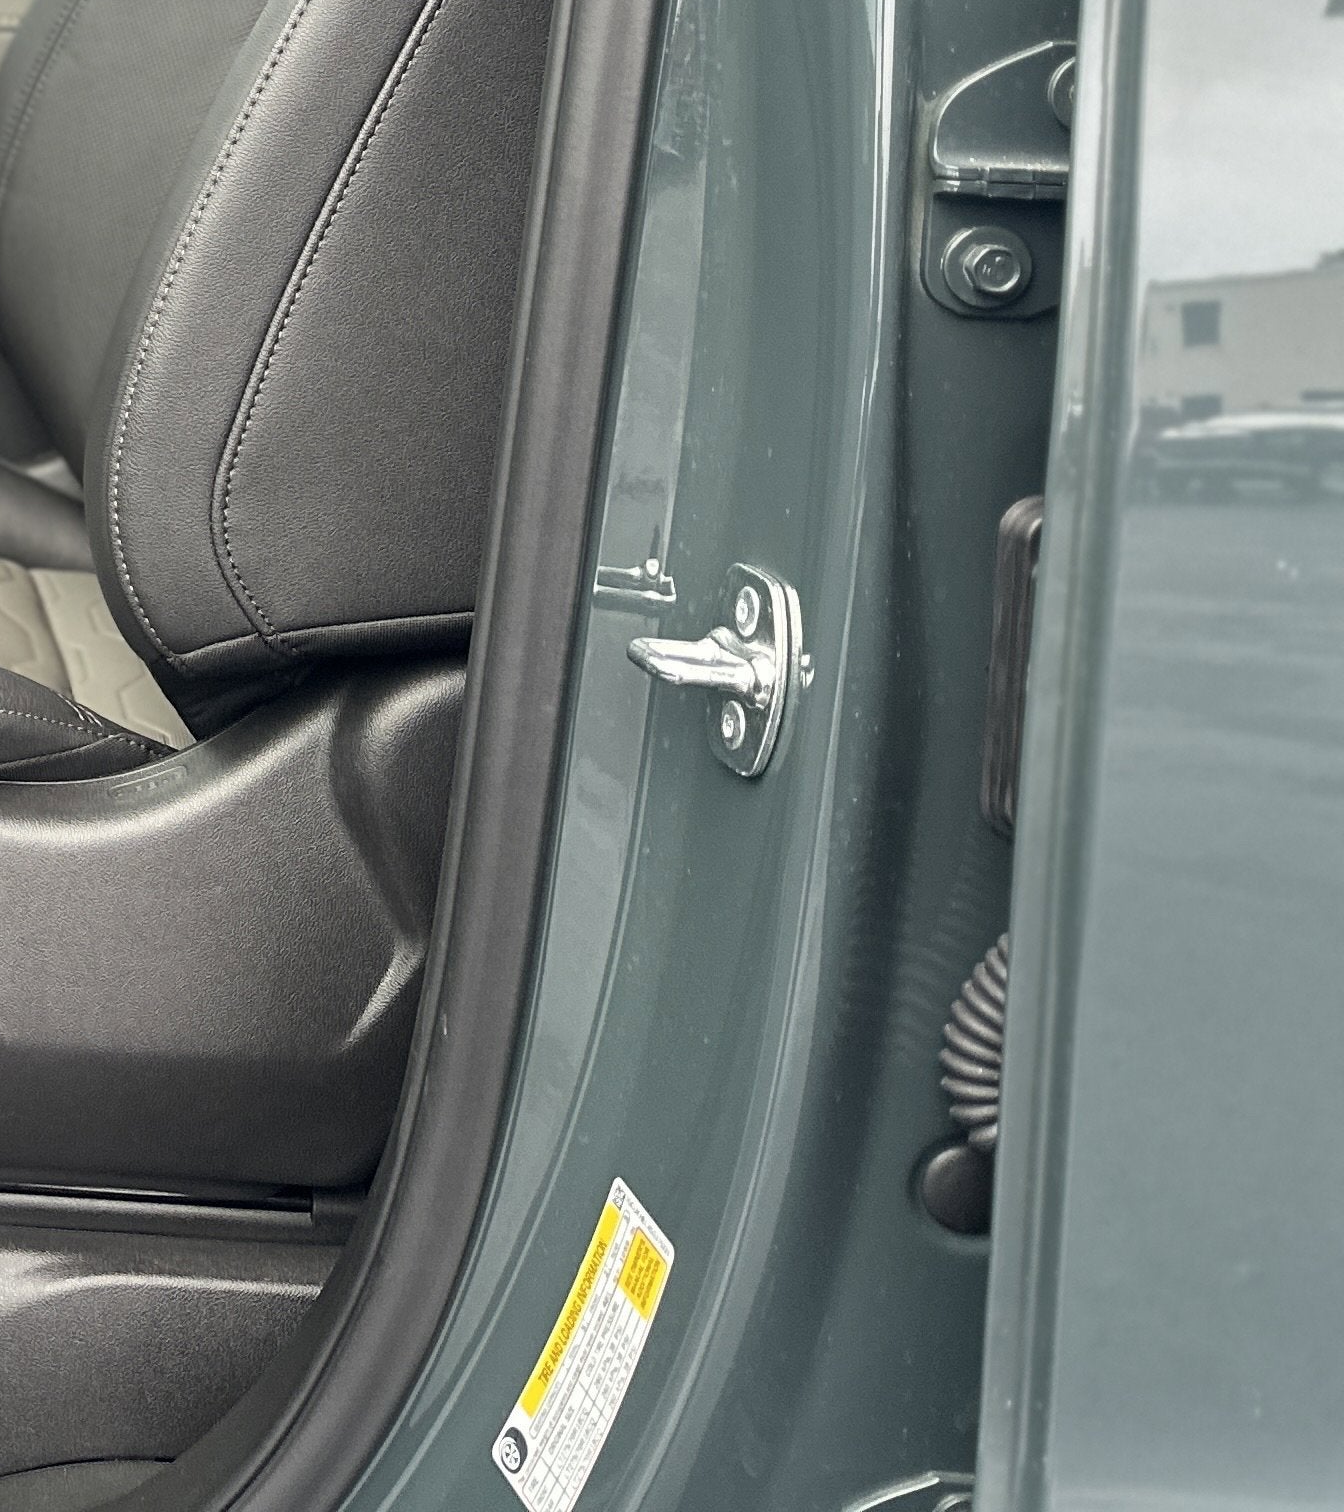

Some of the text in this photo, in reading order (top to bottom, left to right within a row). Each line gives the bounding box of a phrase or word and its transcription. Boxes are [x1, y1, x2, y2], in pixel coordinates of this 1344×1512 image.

[538, 1361, 553, 1388] TIRE
[551, 1341, 564, 1366] AND
[558, 1300, 583, 1346] LOADING
[577, 1240, 609, 1305] INFORMATION
